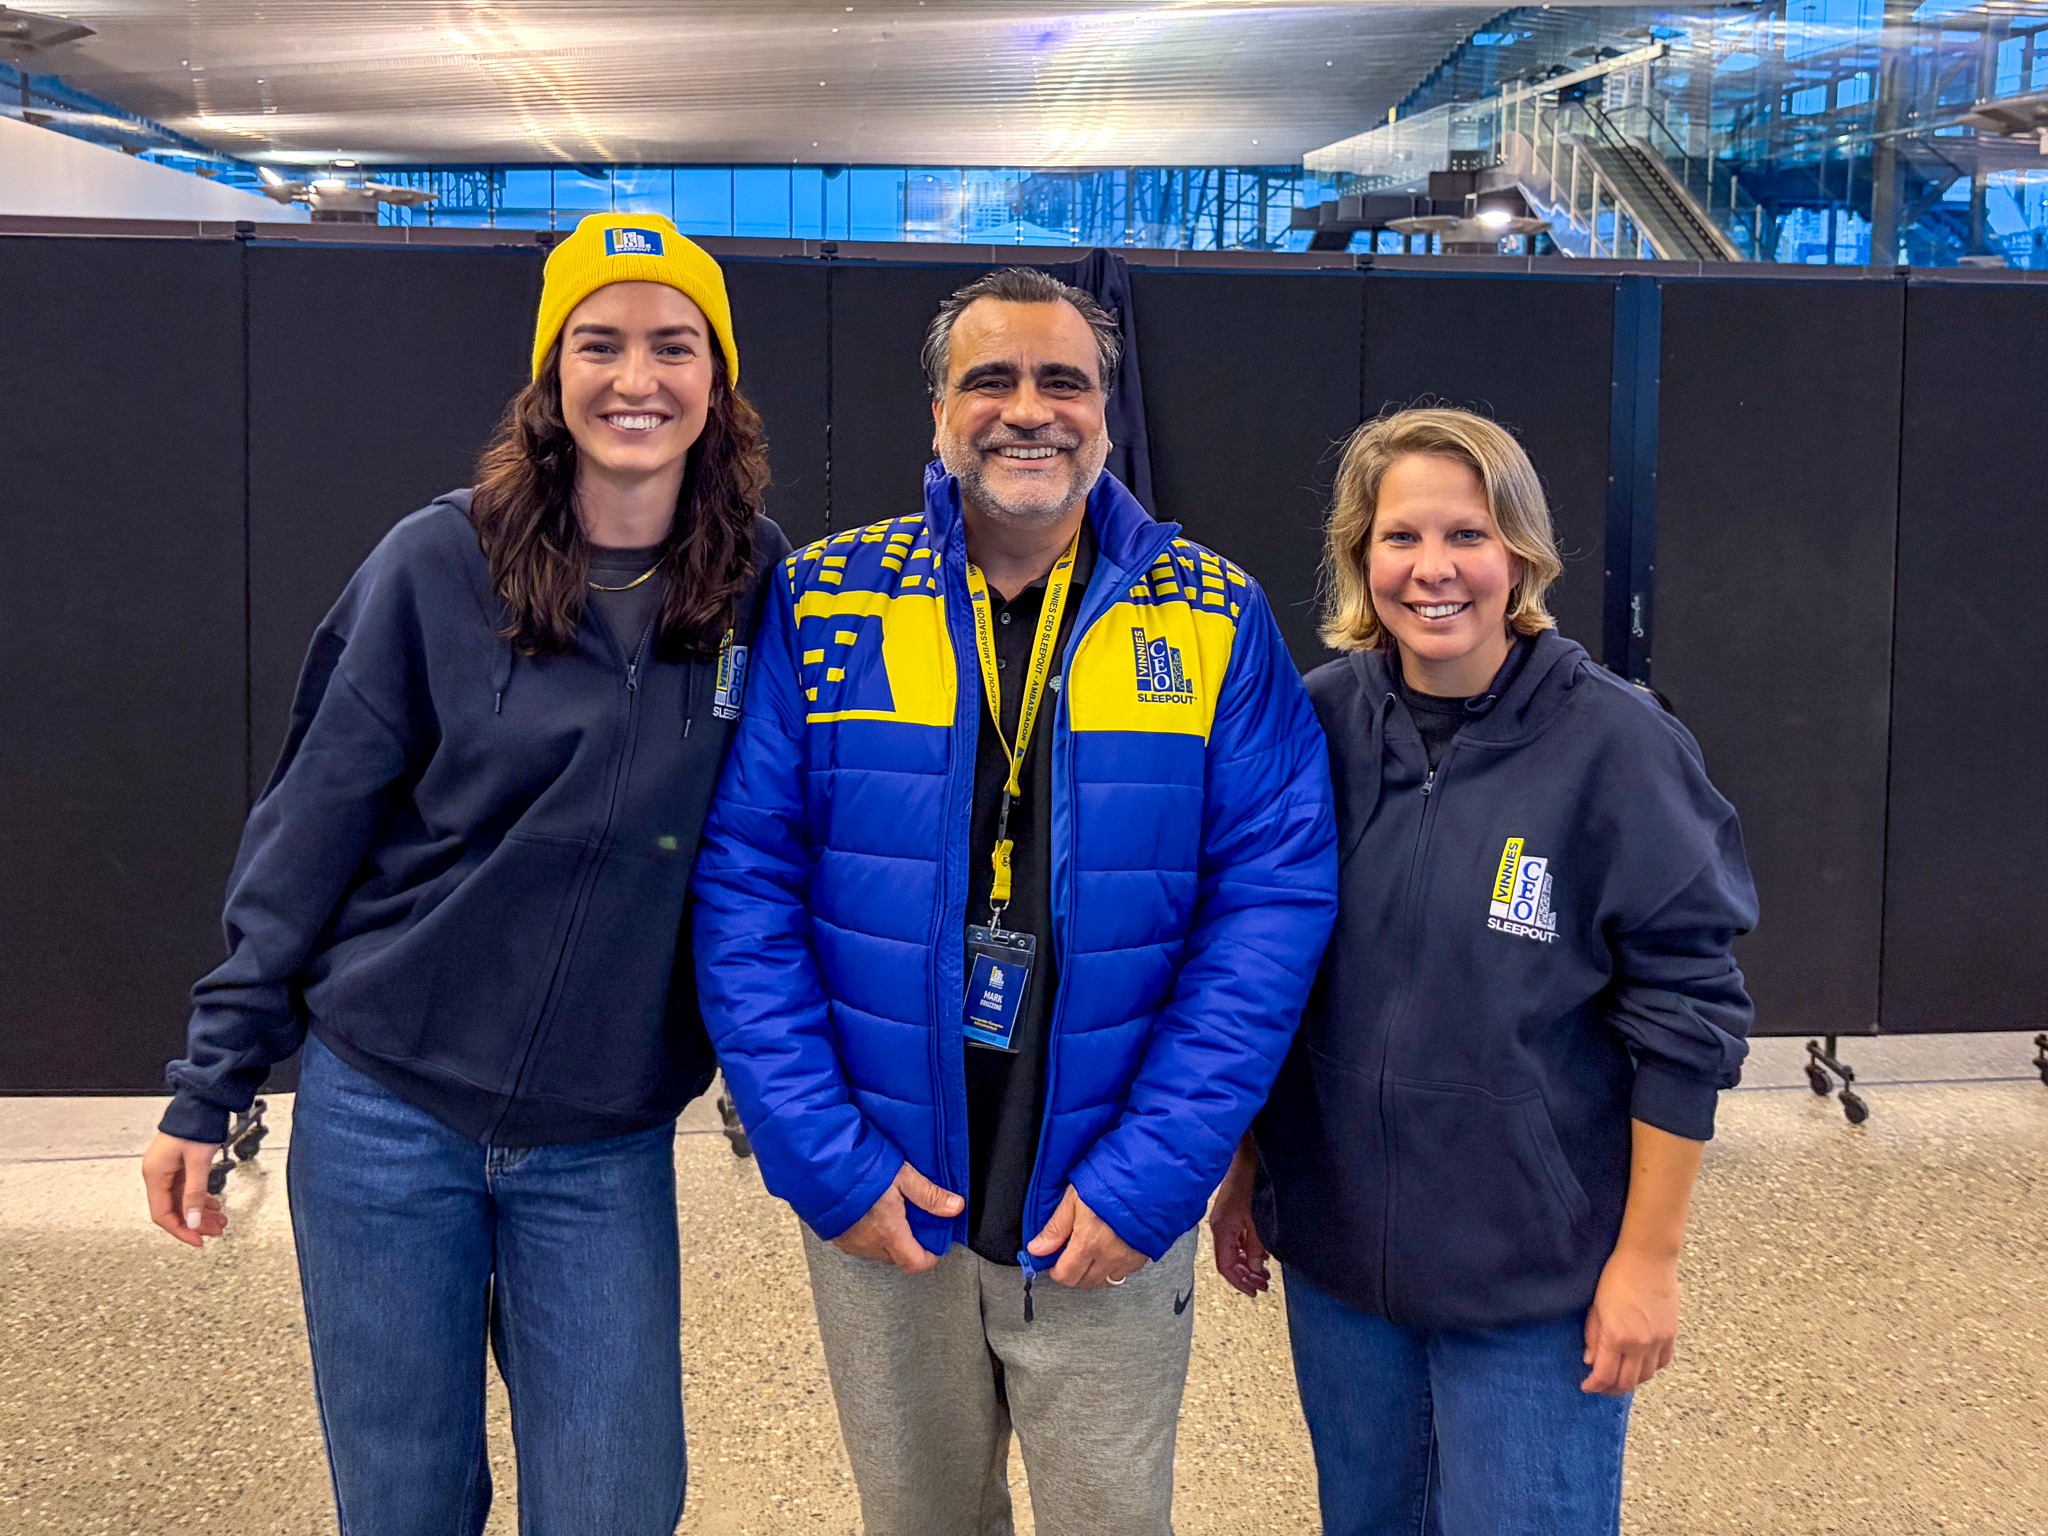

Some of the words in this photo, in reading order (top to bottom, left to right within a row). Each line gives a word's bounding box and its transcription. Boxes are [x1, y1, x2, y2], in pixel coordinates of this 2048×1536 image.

[1048, 583, 1063, 613] VINNIES
[975, 607, 991, 665] AMBASSADOR
[1044, 615, 1055, 632] CEO
[1034, 634, 1051, 675] SLEEPOUT
[1134, 630, 1149, 676] VINNIES
[1149, 640, 1171, 690] CEO
[729, 650, 746, 706] CEO
[1137, 693, 1194, 705] SLEEPOUT
[1021, 679, 1039, 741] AMBASSADOR
[1496, 842, 1519, 898] VINNIES
[1513, 861, 1542, 921] CEO
[1487, 917, 1555, 944] SLEEPOUT
[983, 990, 1004, 1004] MARK
